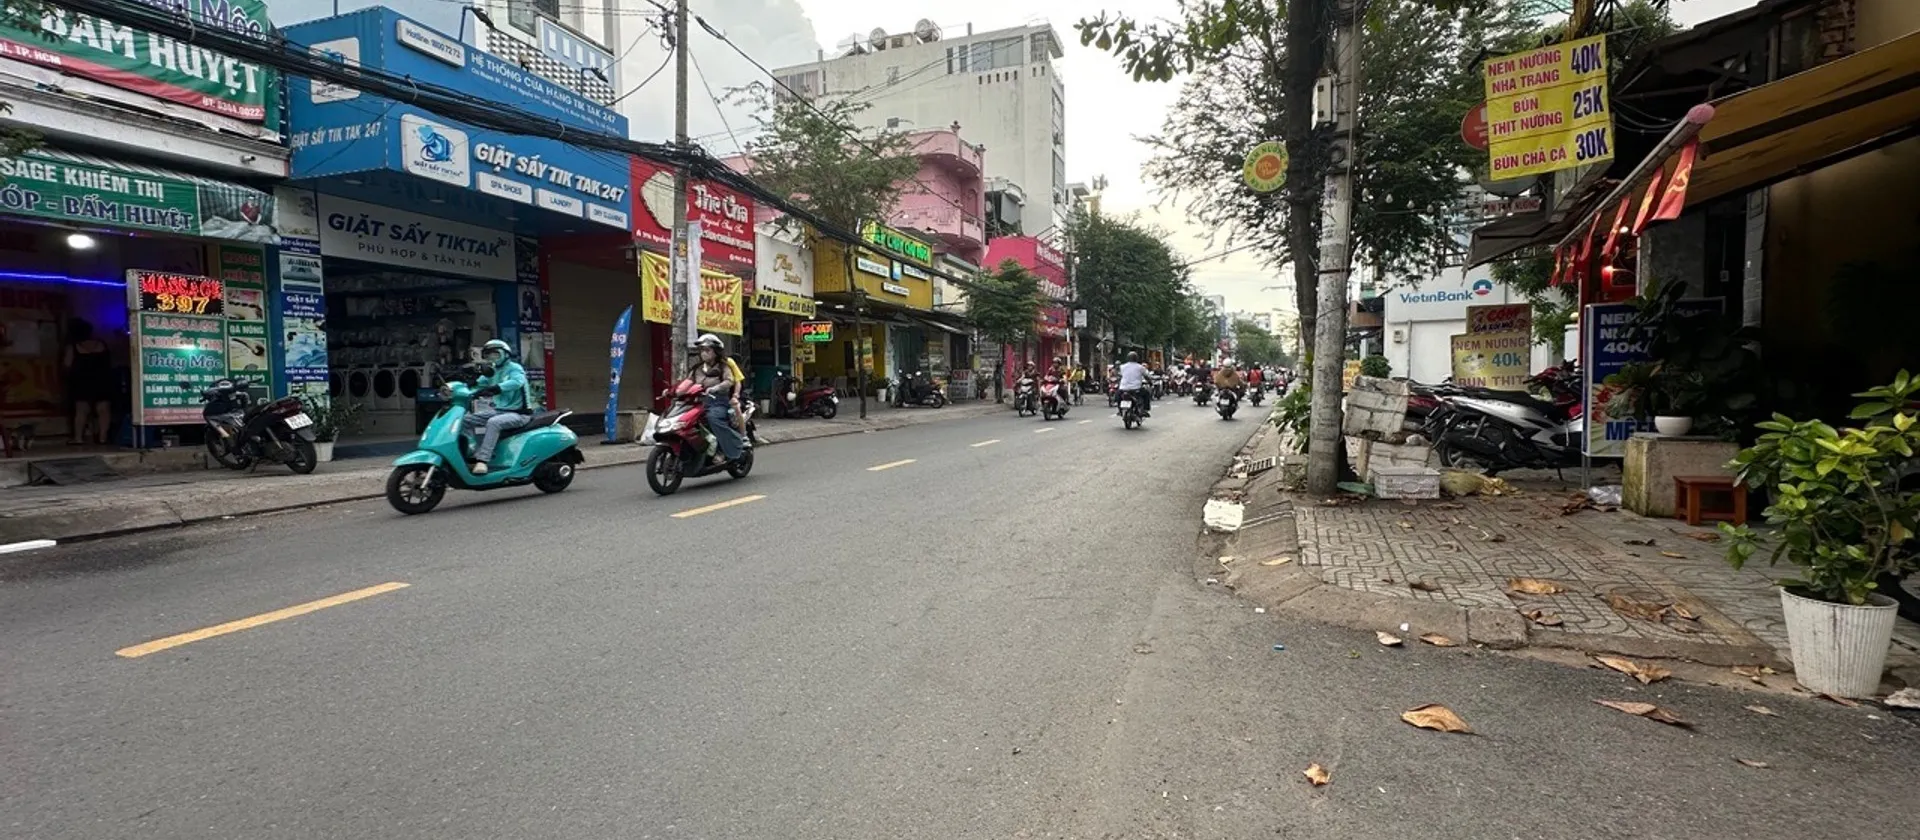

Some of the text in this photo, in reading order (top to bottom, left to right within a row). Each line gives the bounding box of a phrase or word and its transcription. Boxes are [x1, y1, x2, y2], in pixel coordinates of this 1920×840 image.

[1488, 61, 1516, 77] NEM
[1570, 42, 1603, 76] 40K
[1492, 69, 1560, 94] NHA TRANG
[1513, 96, 1539, 114] BÚN
[1573, 85, 1604, 120] 25K
[602, 110, 616, 124] 247
[1492, 120, 1517, 137] THỊT
[328, 127, 343, 143] TIK
[345, 124, 362, 140] TAK
[364, 122, 382, 138] 247
[1575, 127, 1609, 162] 30K
[1493, 144, 1567, 171] BÚN CHẢ CÁ
[474, 143, 625, 203] GIẶT SẤY TIK TAK 247
[134, 179, 164, 202] THỊ
[691, 184, 722, 214] The
[62, 194, 119, 220] BẤM
[123, 204, 193, 232] HUYỆT
[328, 213, 385, 239] GIẶT
[389, 222, 431, 246] SẤY
[436, 232, 500, 258] TIKTAK
[141, 276, 222, 299] MASSAGE
[1399, 290, 1474, 304] VietinBank
[156, 293, 209, 314] 397
[145, 317, 220, 332] MASSAGE
